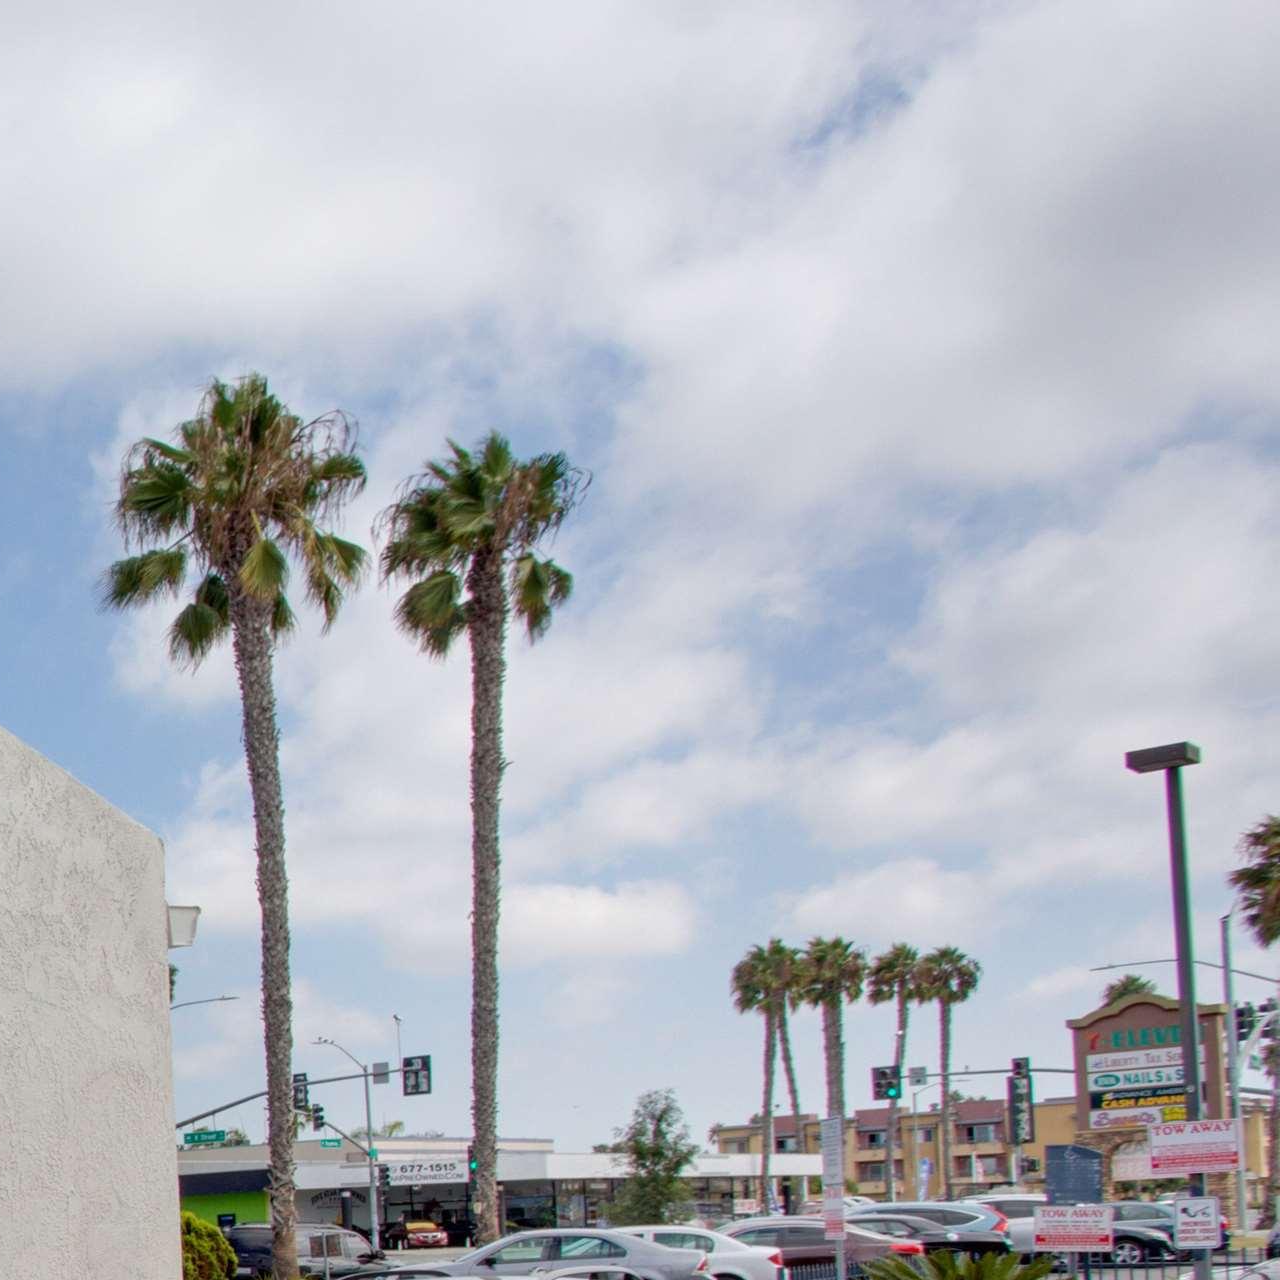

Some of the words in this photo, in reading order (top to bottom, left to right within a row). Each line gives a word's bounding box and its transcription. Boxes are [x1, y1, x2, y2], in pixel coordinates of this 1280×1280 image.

[1088, 1023, 1204, 1050] 7-ELEVE
[1123, 1070, 1163, 1084] NAILS
[1103, 1098, 1136, 1109] CASH
[1152, 1123, 1185, 1136] TOW
[1190, 1120, 1232, 1134] AWAY
[399, 1163, 457, 1174] 677-1515
[1042, 1209, 1068, 1218] TOW
[1071, 1209, 1106, 1218] AWAY
